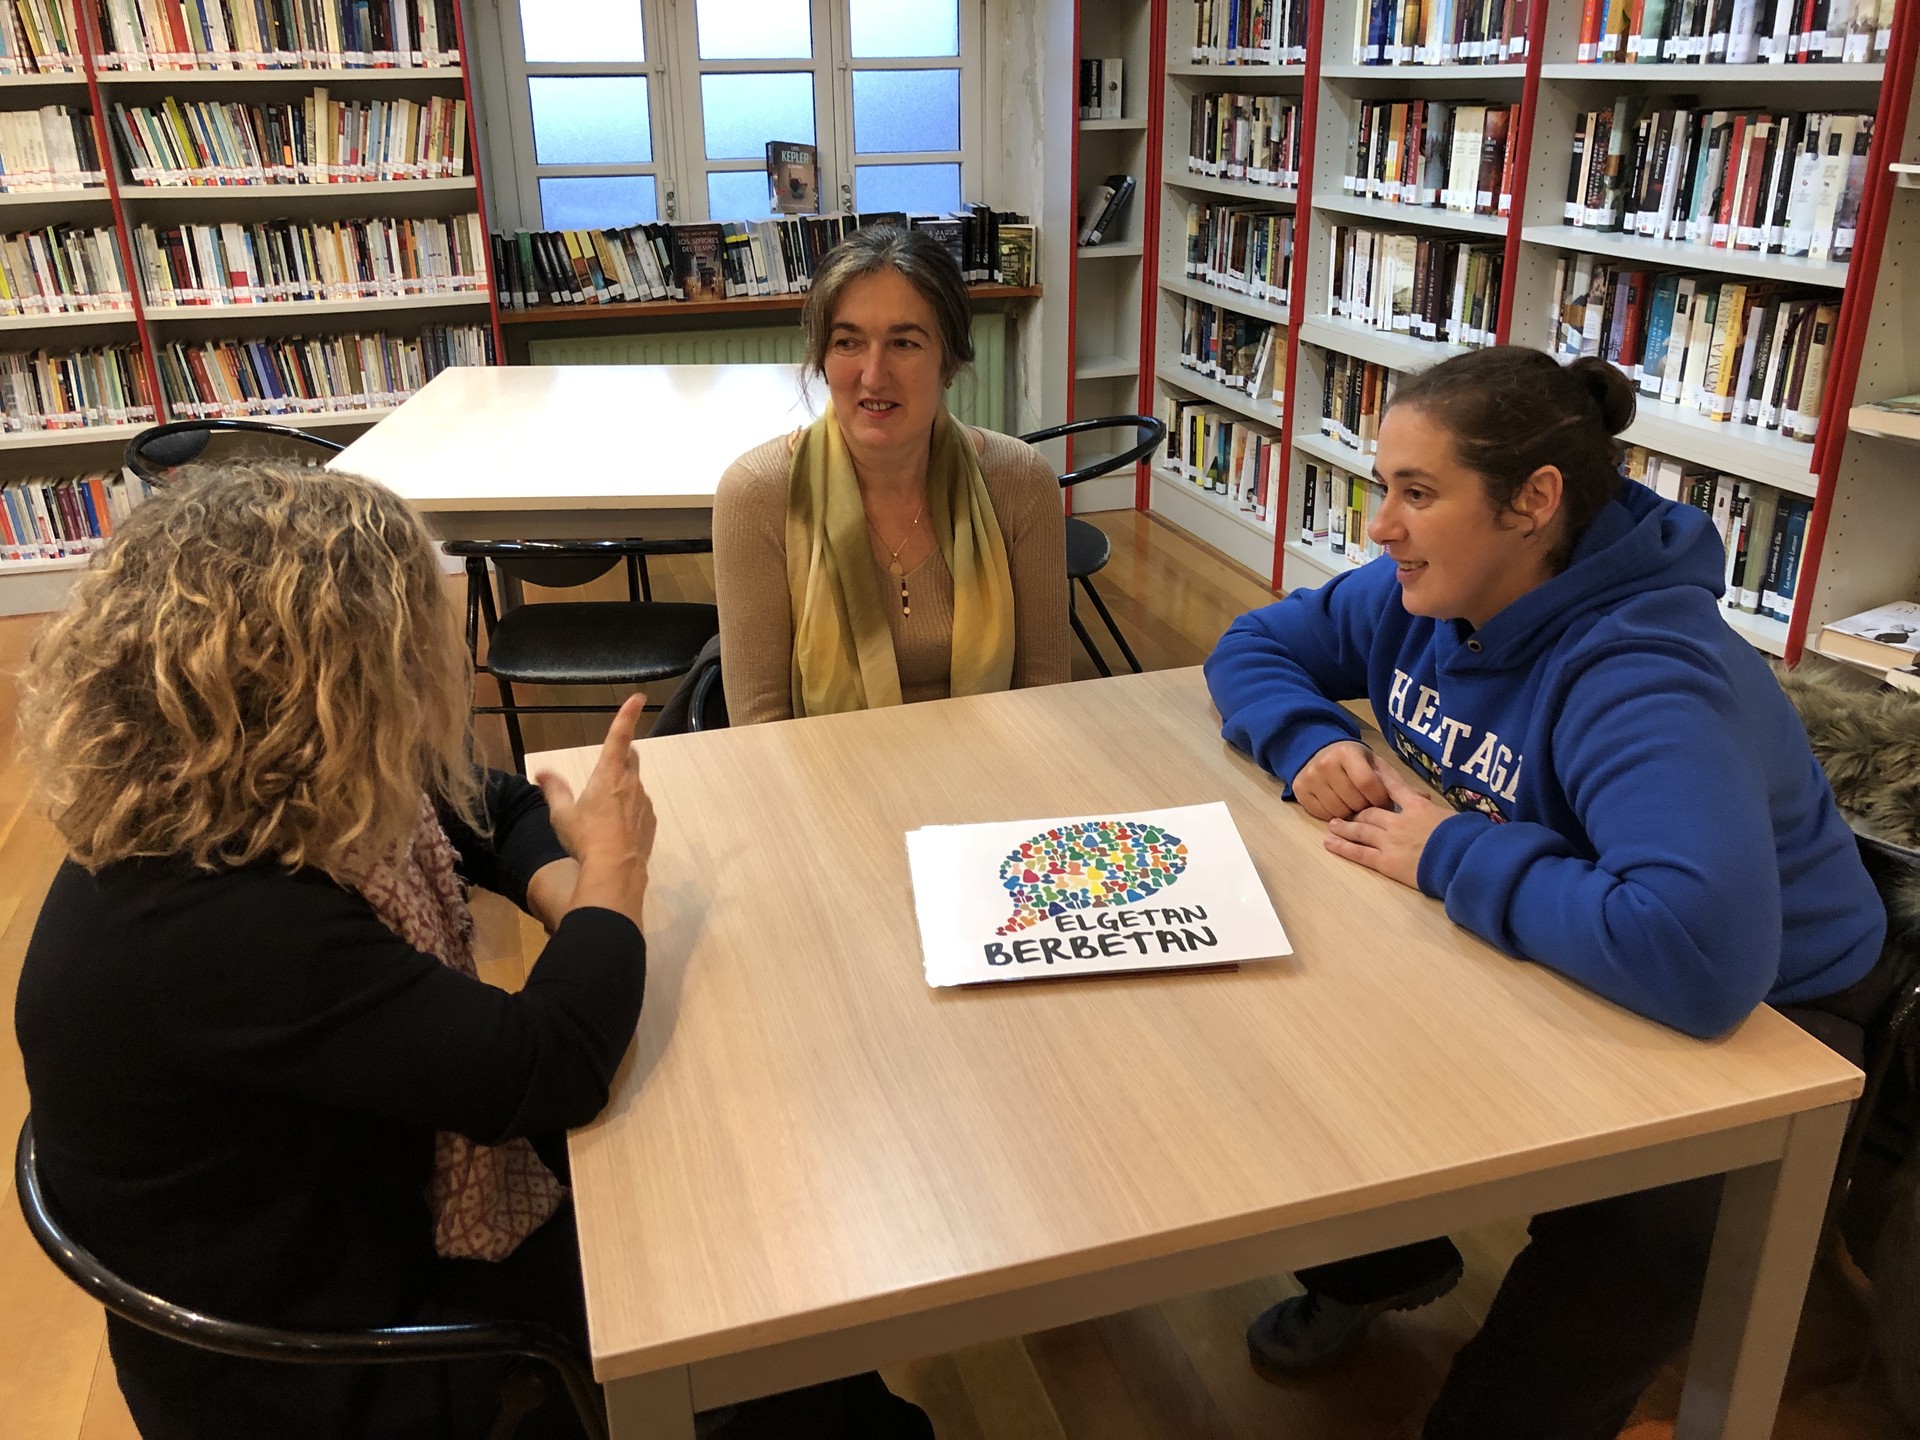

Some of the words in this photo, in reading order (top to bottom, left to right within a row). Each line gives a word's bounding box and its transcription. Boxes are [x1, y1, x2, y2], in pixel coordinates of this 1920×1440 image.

[781, 150, 809, 164] KEPLER
[1763, 333, 1771, 353] ALICE
[1705, 343, 1724, 394] ROMA
[1757, 352, 1768, 379] SEBOLD
[1702, 479, 1712, 507] DAMA
[1055, 905, 1208, 933] ELGETAN
[983, 925, 1219, 967] BERBETAN
